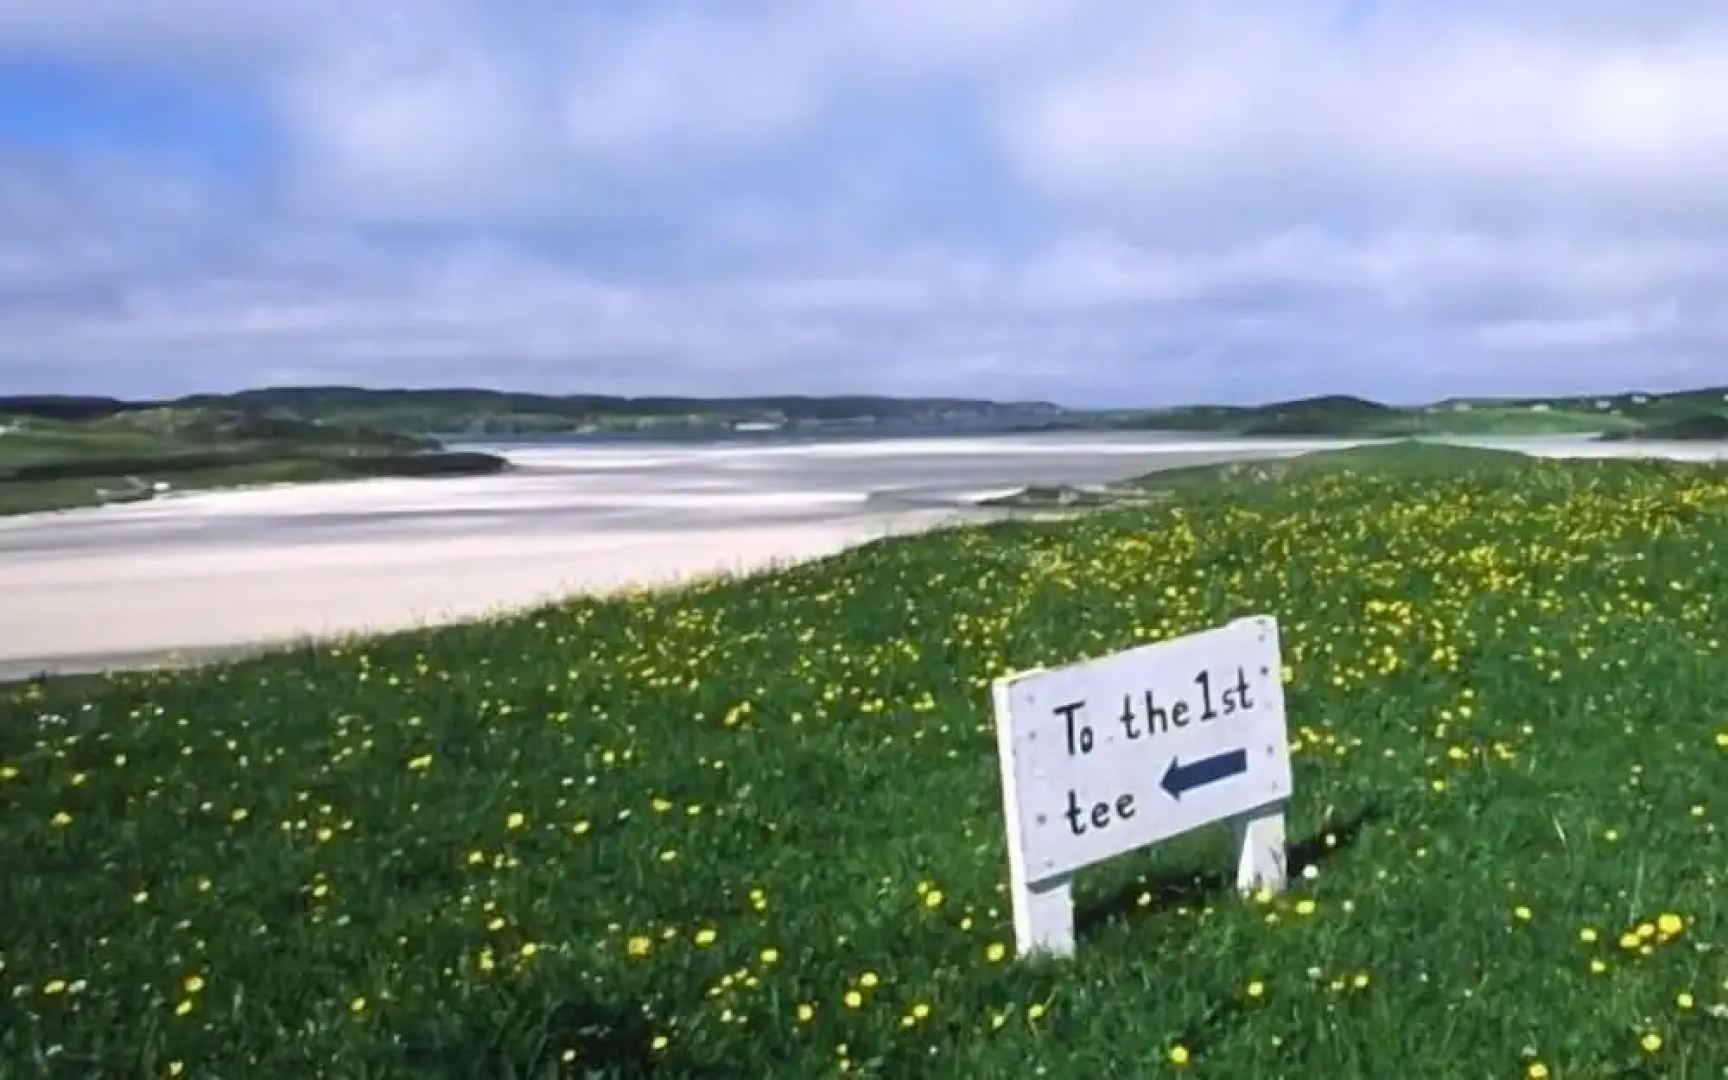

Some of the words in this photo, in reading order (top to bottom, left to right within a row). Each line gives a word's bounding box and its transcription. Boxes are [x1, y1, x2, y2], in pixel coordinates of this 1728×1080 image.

[1053, 700, 1094, 756] To
[1120, 689, 1190, 740] the
[1194, 665, 1254, 722] 1st
[1065, 789, 1136, 836] tee
